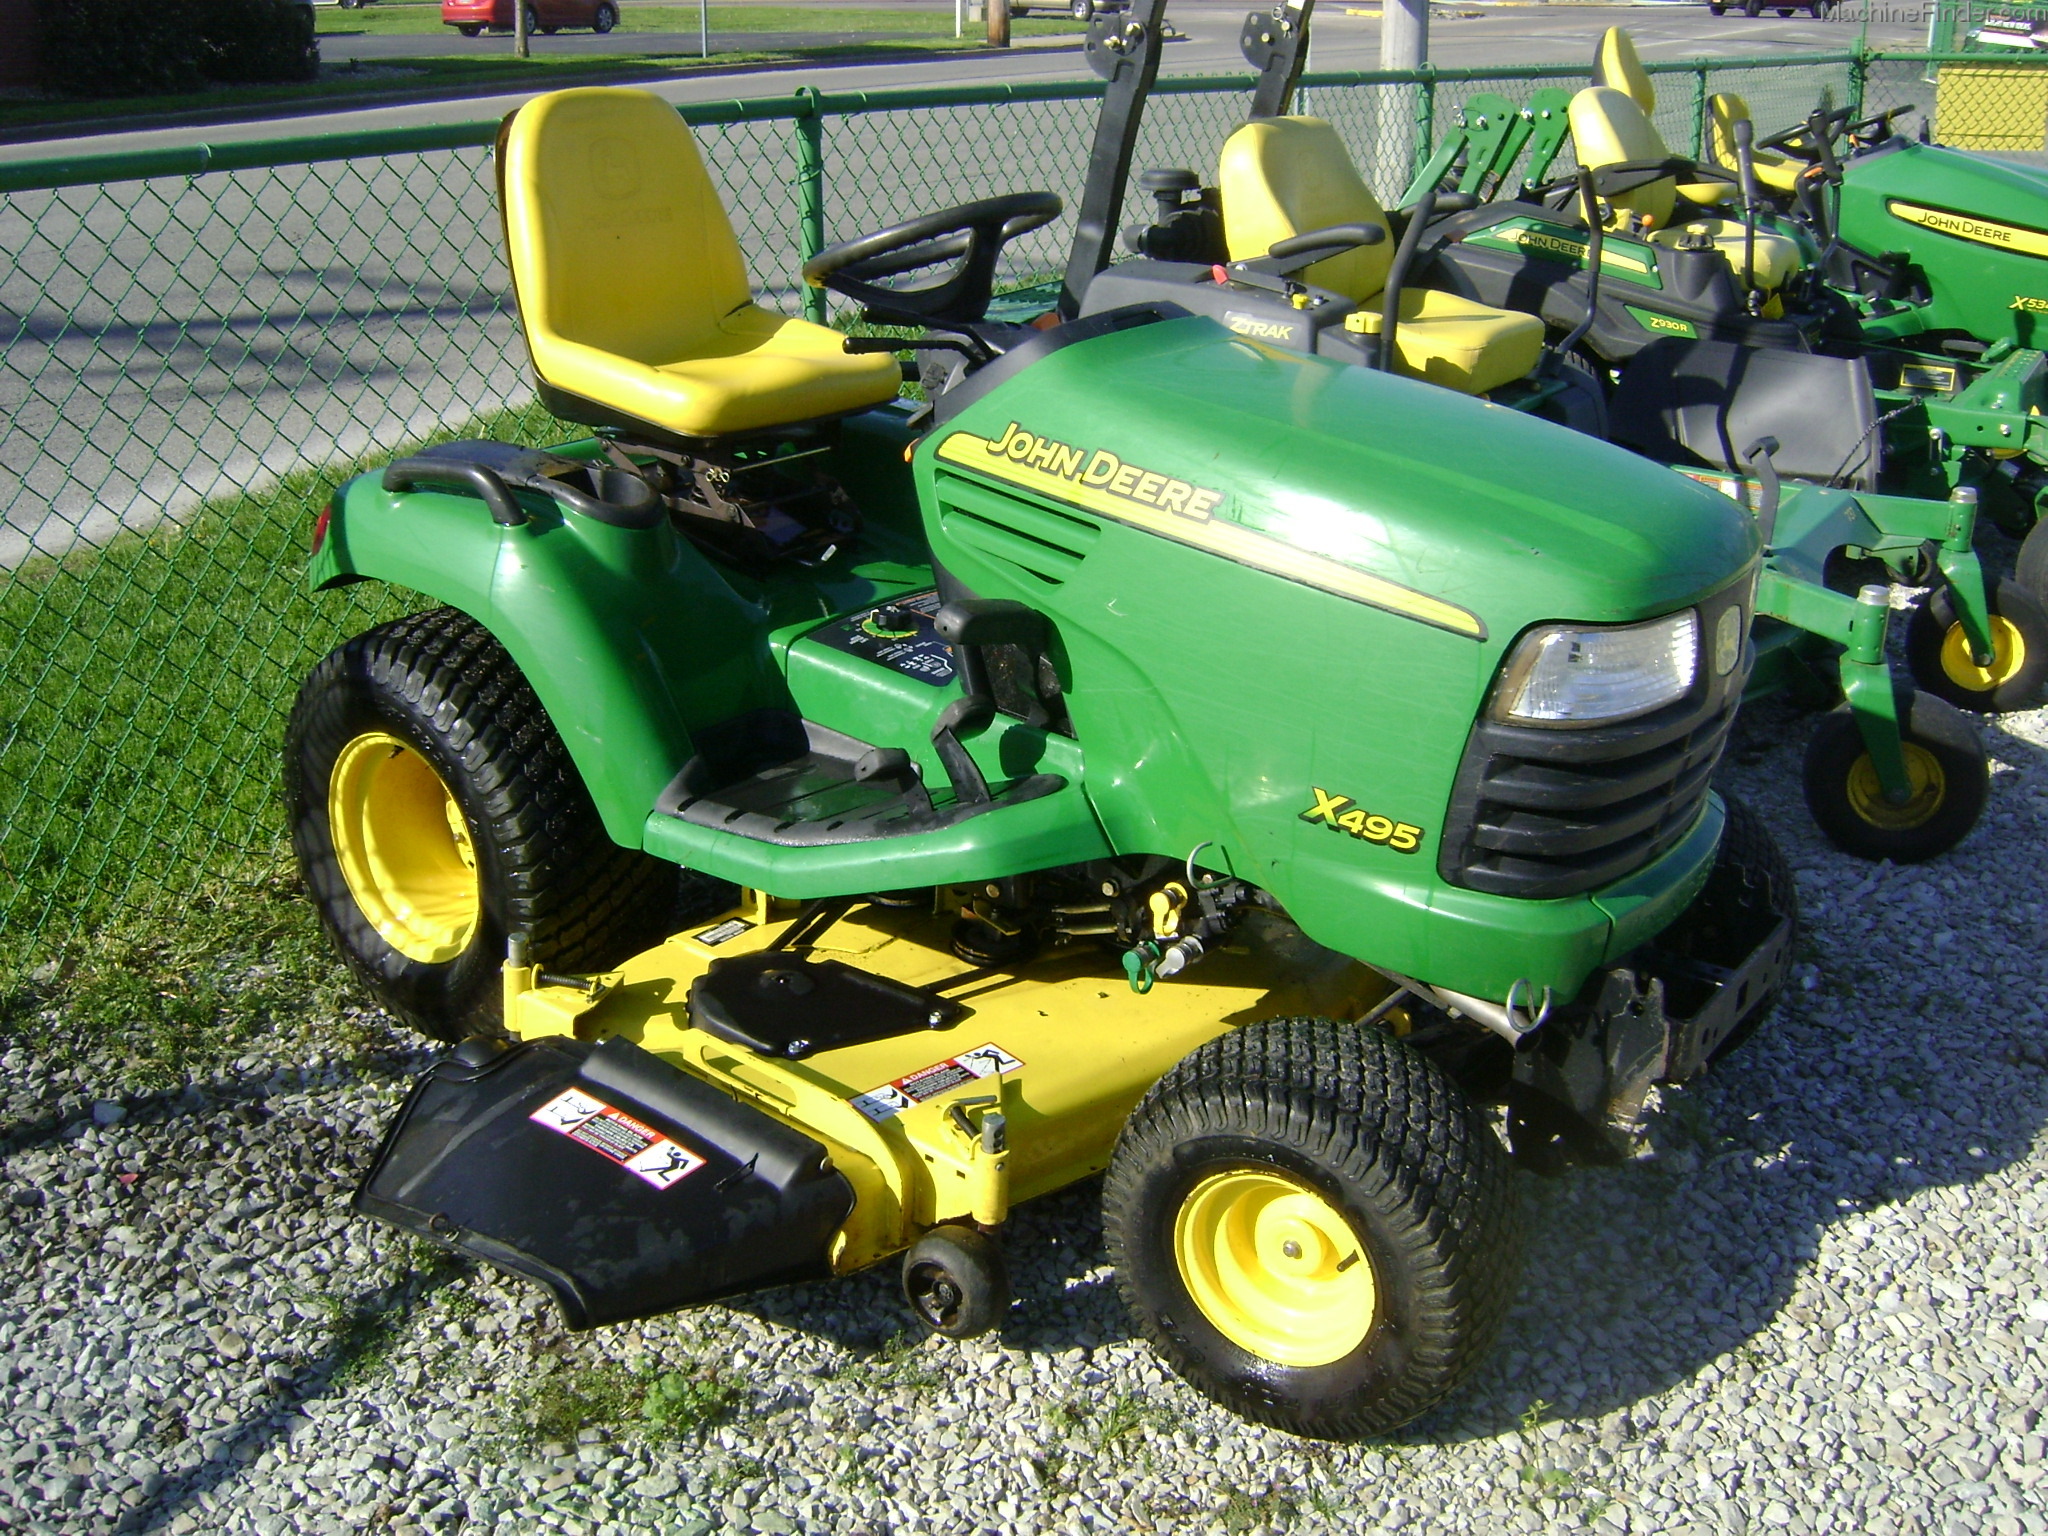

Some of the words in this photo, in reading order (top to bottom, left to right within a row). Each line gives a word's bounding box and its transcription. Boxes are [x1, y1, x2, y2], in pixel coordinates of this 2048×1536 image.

[1918, 212, 1960, 231] JOHN
[1962, 221, 2012, 242] DEERE
[1510, 232, 1547, 248] JOHN
[1229, 316, 1294, 340] ZTRAK
[1650, 317, 1688, 332] Z930R
[987, 421, 1086, 479] JOHN
[1081, 450, 1223, 523] DEERE
[1299, 787, 1425, 854] X495
[910, 1062, 950, 1081] DANGER
[617, 1116, 656, 1140] DANGER
